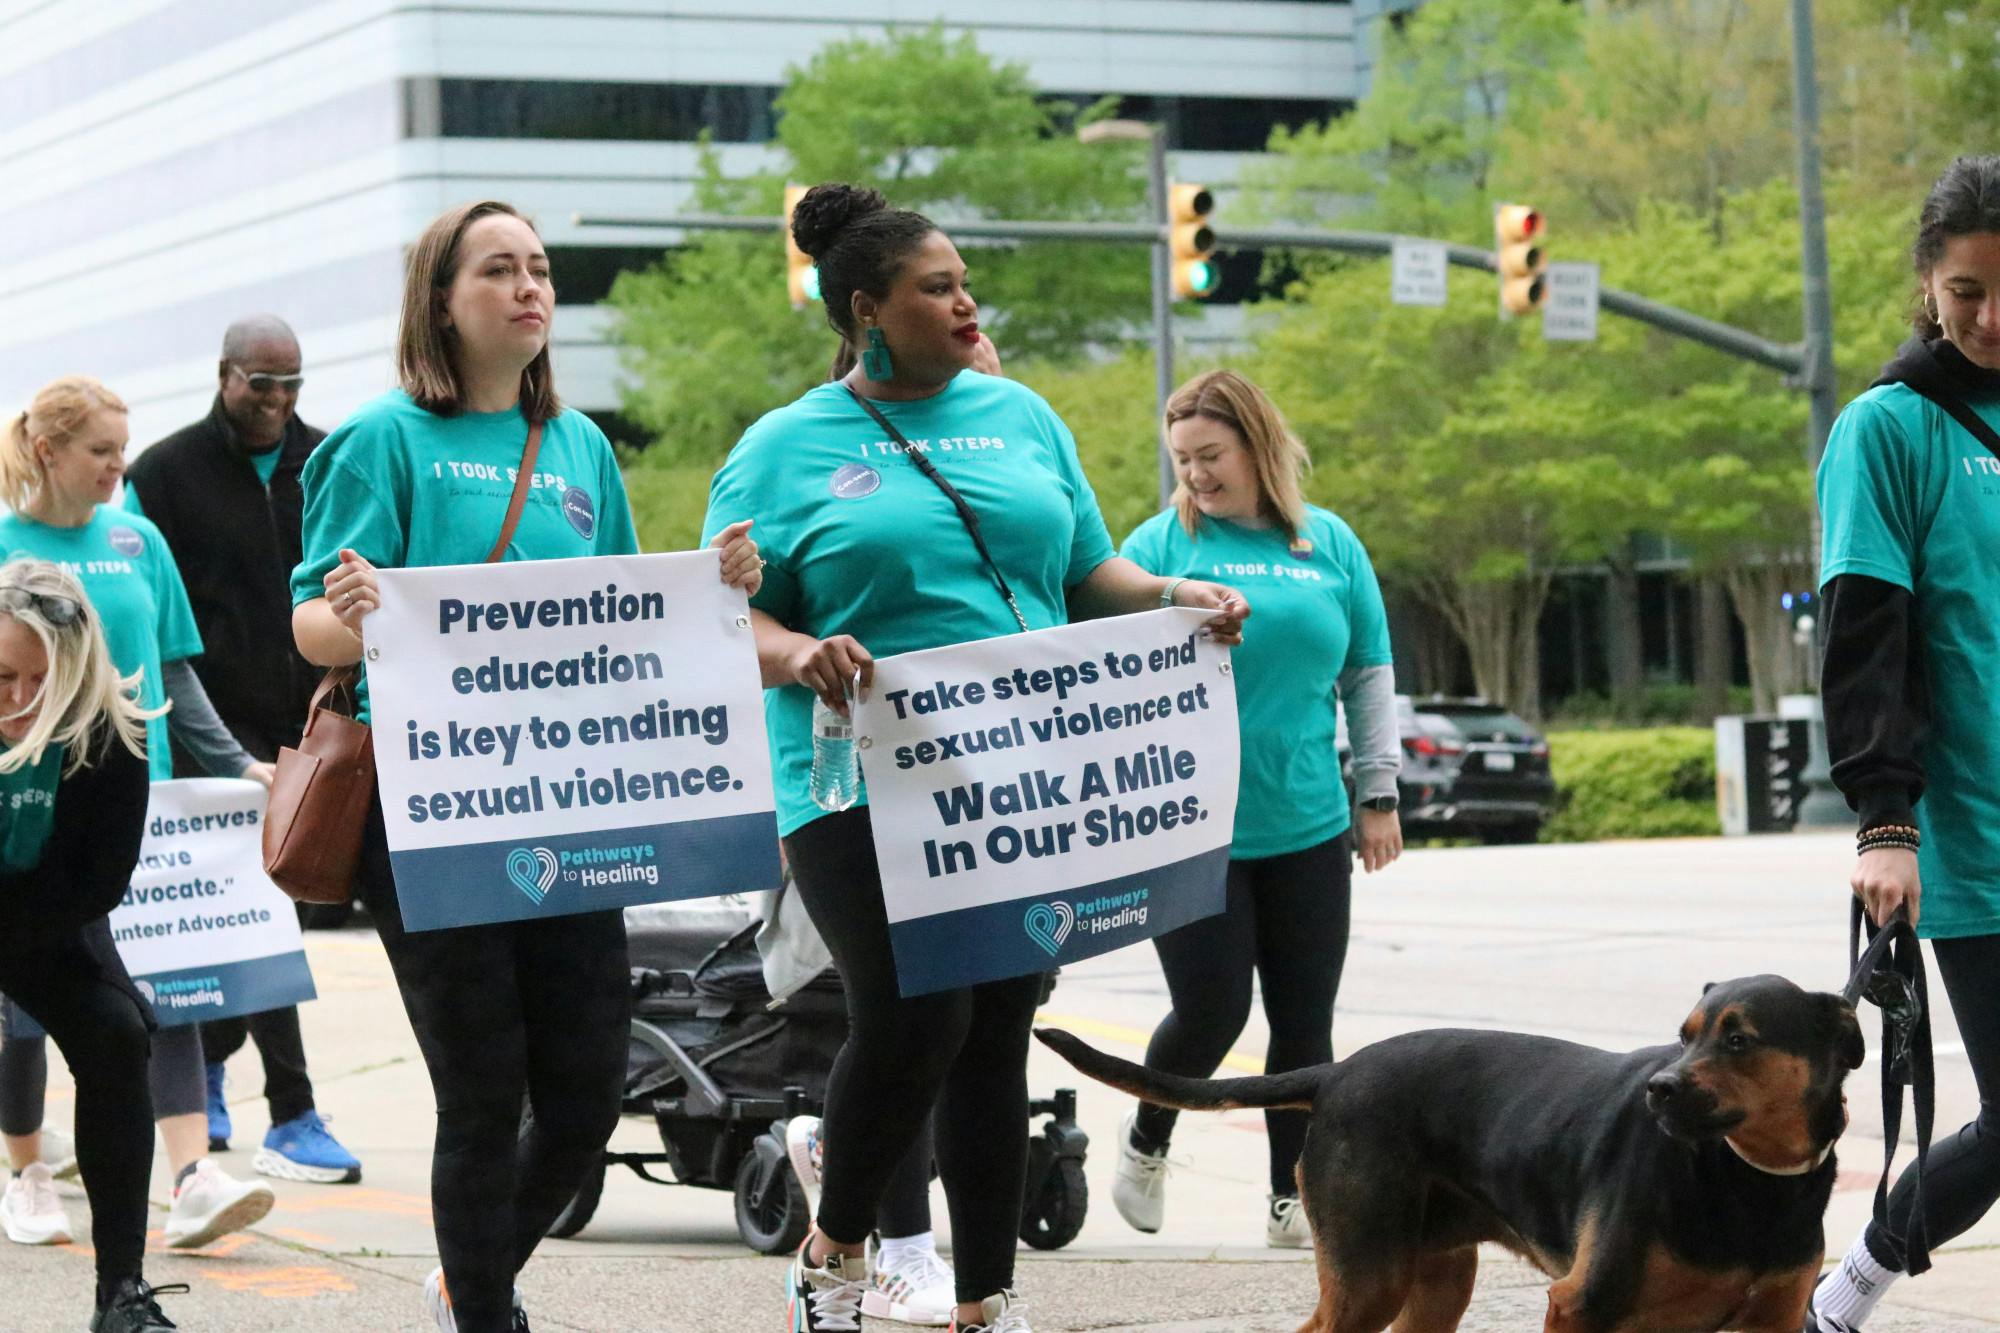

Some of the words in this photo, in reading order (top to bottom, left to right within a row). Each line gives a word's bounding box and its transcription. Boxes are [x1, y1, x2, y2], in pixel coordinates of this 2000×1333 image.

[875, 438, 932, 456] TOK
[939, 437, 1005, 451] STEPS
[448, 461, 501, 481] TOOK
[506, 467, 567, 492] SEPS
[86, 560, 132, 575] STEPS
[1224, 563, 1268, 577] TOOK
[1273, 564, 1322, 582] STEPS
[439, 584, 664, 634] Prevention
[452, 644, 664, 694] education
[885, 680, 985, 720] Take
[992, 660, 1100, 700] steps
[1103, 651, 1143, 679] to
[1148, 634, 1197, 672] end
[406, 719, 441, 761] is
[448, 721, 521, 766] key
[529, 716, 571, 750] to
[578, 698, 729, 746] ending
[894, 716, 1025, 770] sexual
[1029, 695, 1172, 743] violence
[1176, 682, 1209, 714] at
[11, 788, 53, 809] SEPS
[407, 776, 544, 823] sexual
[549, 764, 744, 809] violence.
[932, 769, 1071, 827] Walk
[1080, 762, 1111, 802] A
[1114, 743, 1196, 794] Mile
[151, 809, 258, 837] deserves
[923, 839, 978, 878] In
[986, 821, 1077, 864] Our
[1084, 795, 1208, 847] Shoes.
[560, 844, 655, 867] Pathways
[563, 869, 578, 882] to
[581, 862, 659, 887] Healing
[1076, 888, 1148, 917] Pathways
[178, 908, 271, 934] Advocate
[1077, 920, 1088, 931] to
[1092, 906, 1147, 935] Healing
[155, 976, 220, 994] Pathways
[171, 989, 224, 1009] Healing
